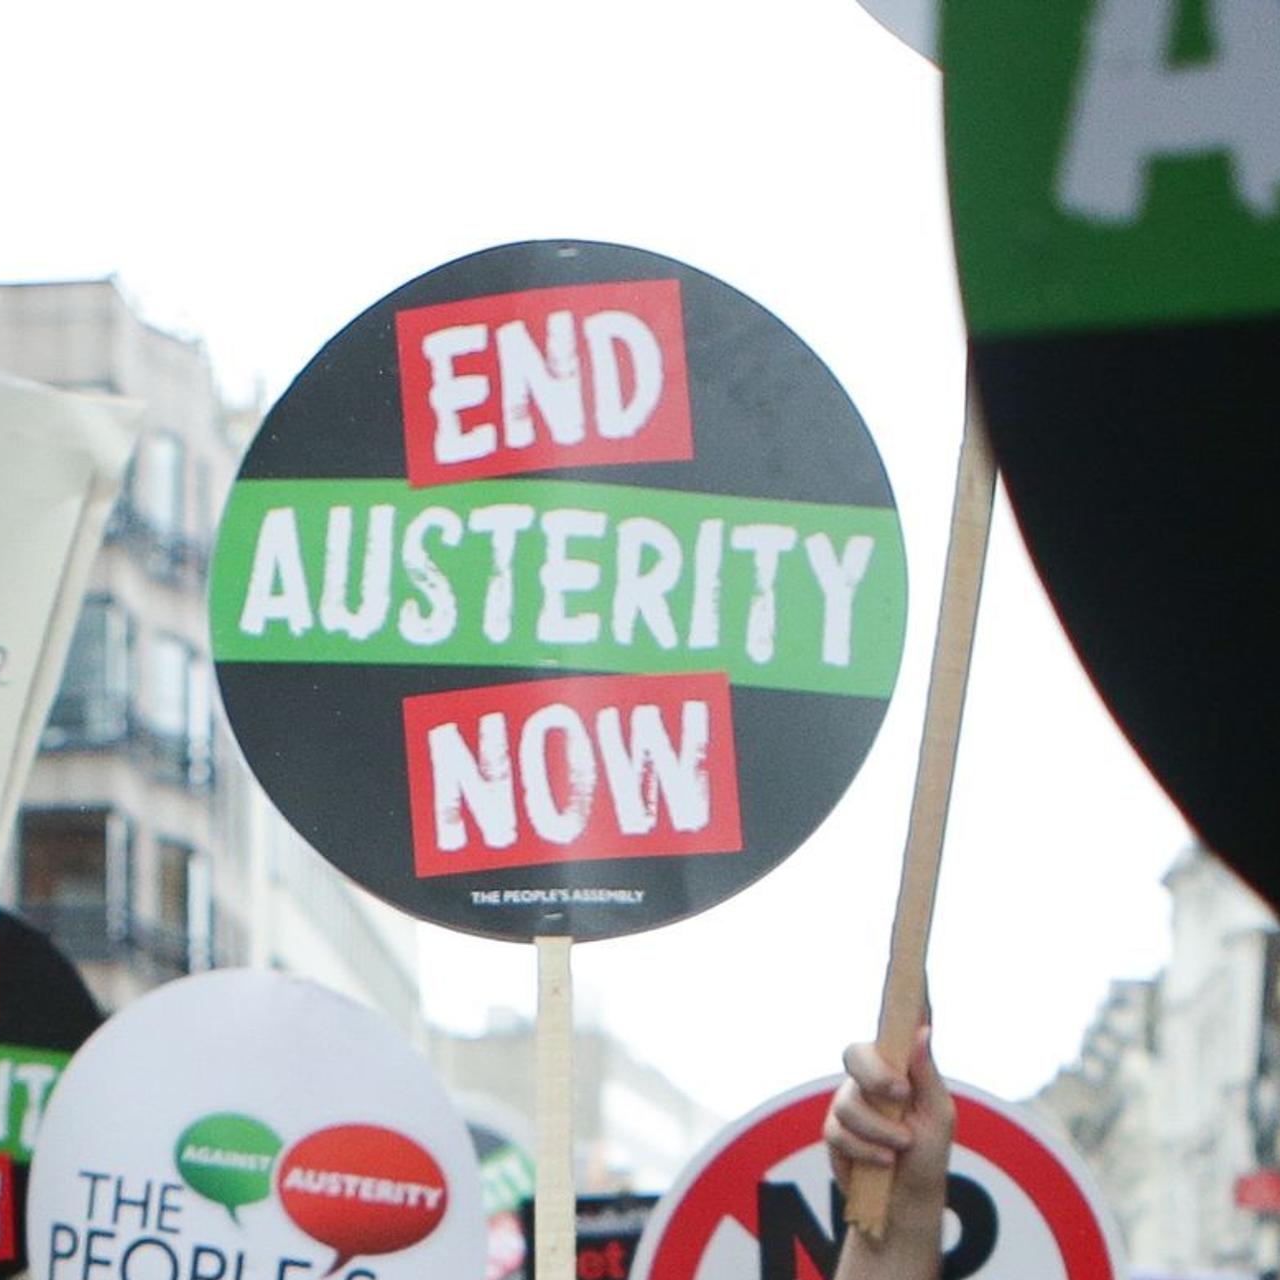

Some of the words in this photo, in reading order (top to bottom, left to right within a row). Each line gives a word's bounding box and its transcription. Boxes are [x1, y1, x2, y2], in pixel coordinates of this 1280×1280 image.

[420, 309, 665, 466] END
[238, 502, 876, 668] AUSTERITY
[426, 699, 711, 853] NOW
[471, 889, 501, 904] THE
[503, 888, 571, 903] PEOPLE'S
[572, 888, 645, 904] ASSEMBLY
[181, 1144, 272, 1172] AGAINST
[285, 1166, 444, 1211] AUSTERITY
[77, 1170, 186, 1235] THE
